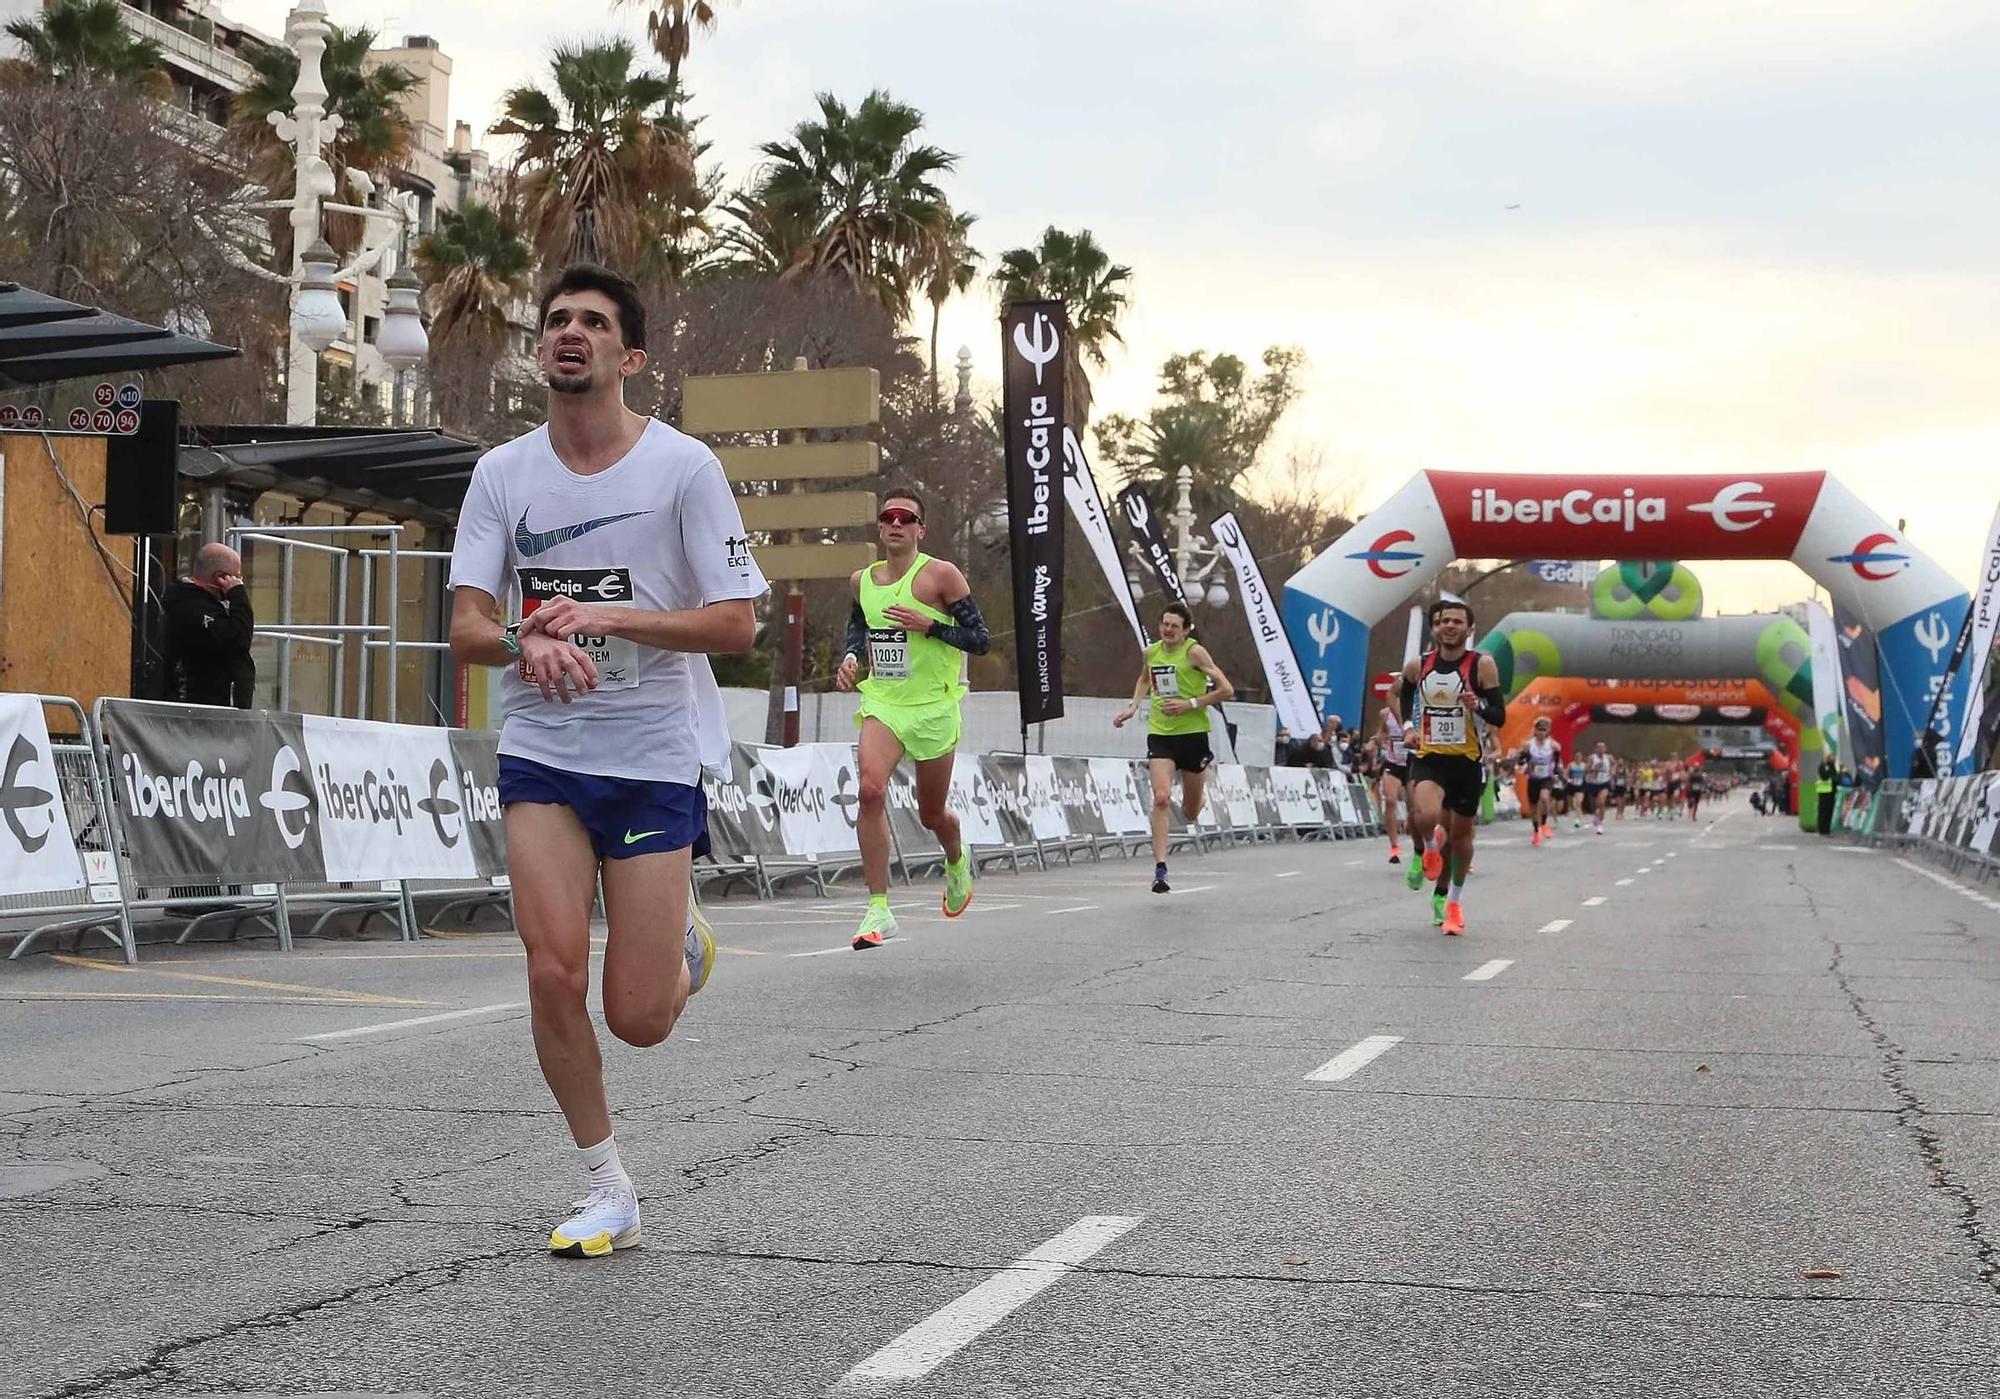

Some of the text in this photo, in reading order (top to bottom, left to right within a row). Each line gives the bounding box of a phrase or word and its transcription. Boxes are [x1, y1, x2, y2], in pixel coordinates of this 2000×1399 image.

[98, 389, 137, 402] 95 N10
[72, 414, 134, 427] 26 70 94
[1024, 396, 1055, 534] iberCaja
[1471, 488, 1666, 532] iberCaja
[727, 556, 750, 568] EKI
[531, 576, 583, 594] iberCaja
[1031, 565, 1052, 622] Vamos
[1037, 626, 1047, 648] DEL
[588, 650, 610, 663] CEM
[874, 648, 904, 663] 12037
[1038, 653, 1050, 692] BANCO
[1438, 721, 1454, 732] 201
[121, 753, 251, 837] iberCaja
[318, 762, 413, 836] iberCaja
[463, 769, 503, 823] iber
